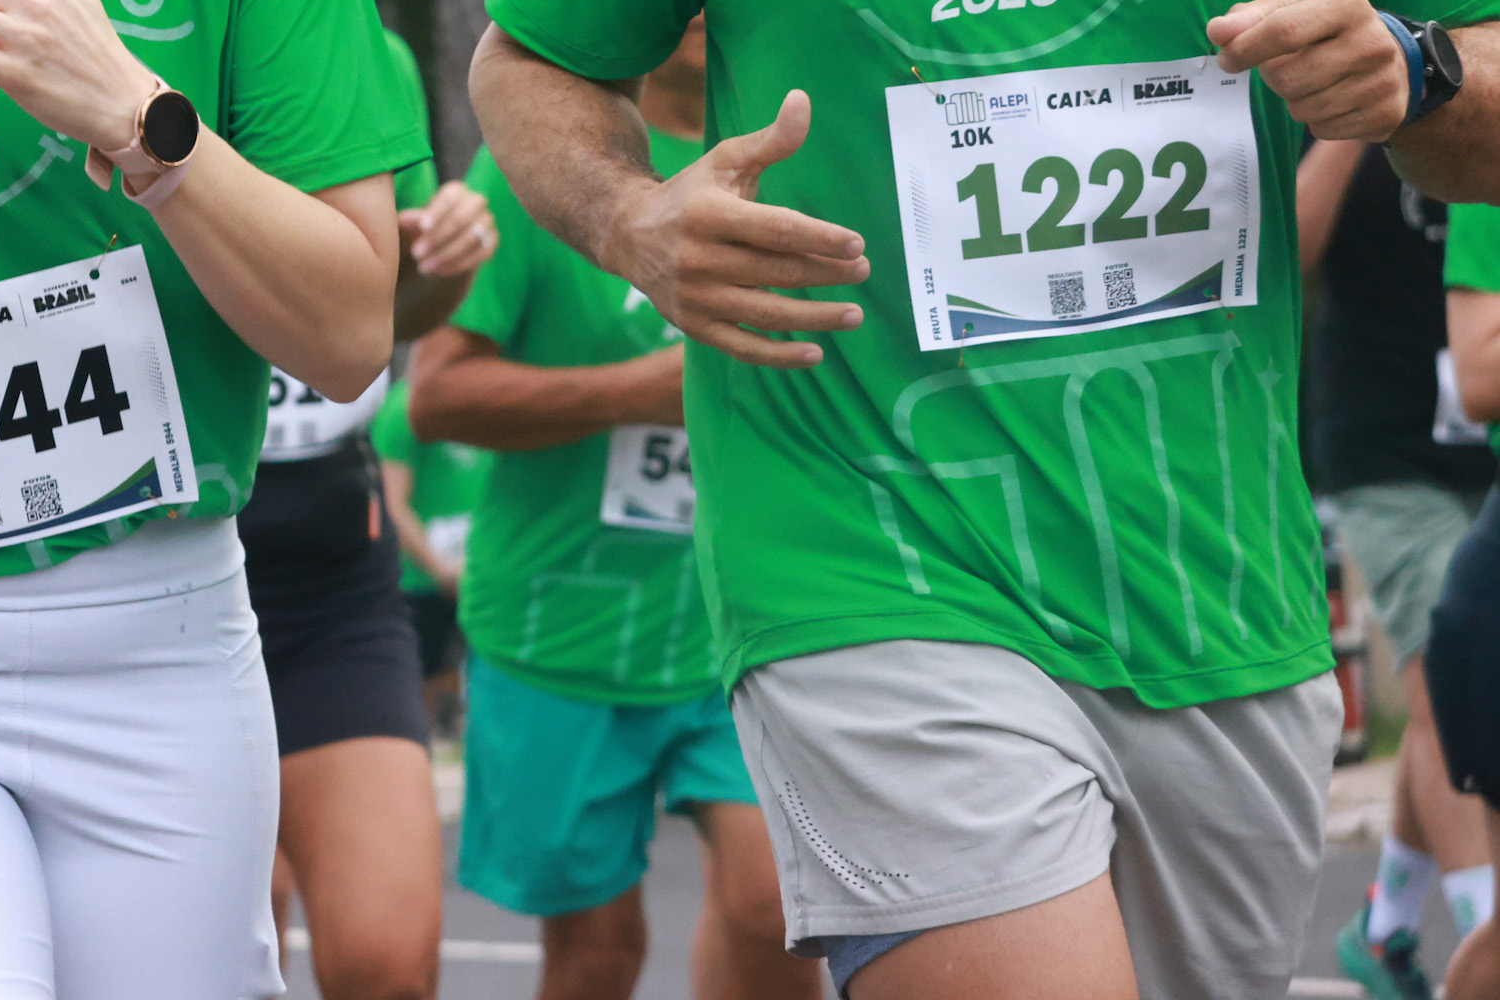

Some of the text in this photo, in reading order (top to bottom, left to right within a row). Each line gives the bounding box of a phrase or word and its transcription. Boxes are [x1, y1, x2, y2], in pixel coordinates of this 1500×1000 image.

[989, 93, 1029, 109] ALEPI
[1046, 88, 1112, 110] CAIXA
[1133, 79, 1194, 101] BRASIL
[950, 126, 994, 149] 10K
[956, 141, 1211, 260] 1222
[1105, 263, 1129, 271] FOTOS
[1235, 228, 1247, 296] MEDALHA 1222
[33, 283, 96, 314] BRASIL
[924, 268, 942, 341] FRUTA 1222
[23, 474, 52, 485] FOTOS
[168, 448, 184, 493] MEDALHA
